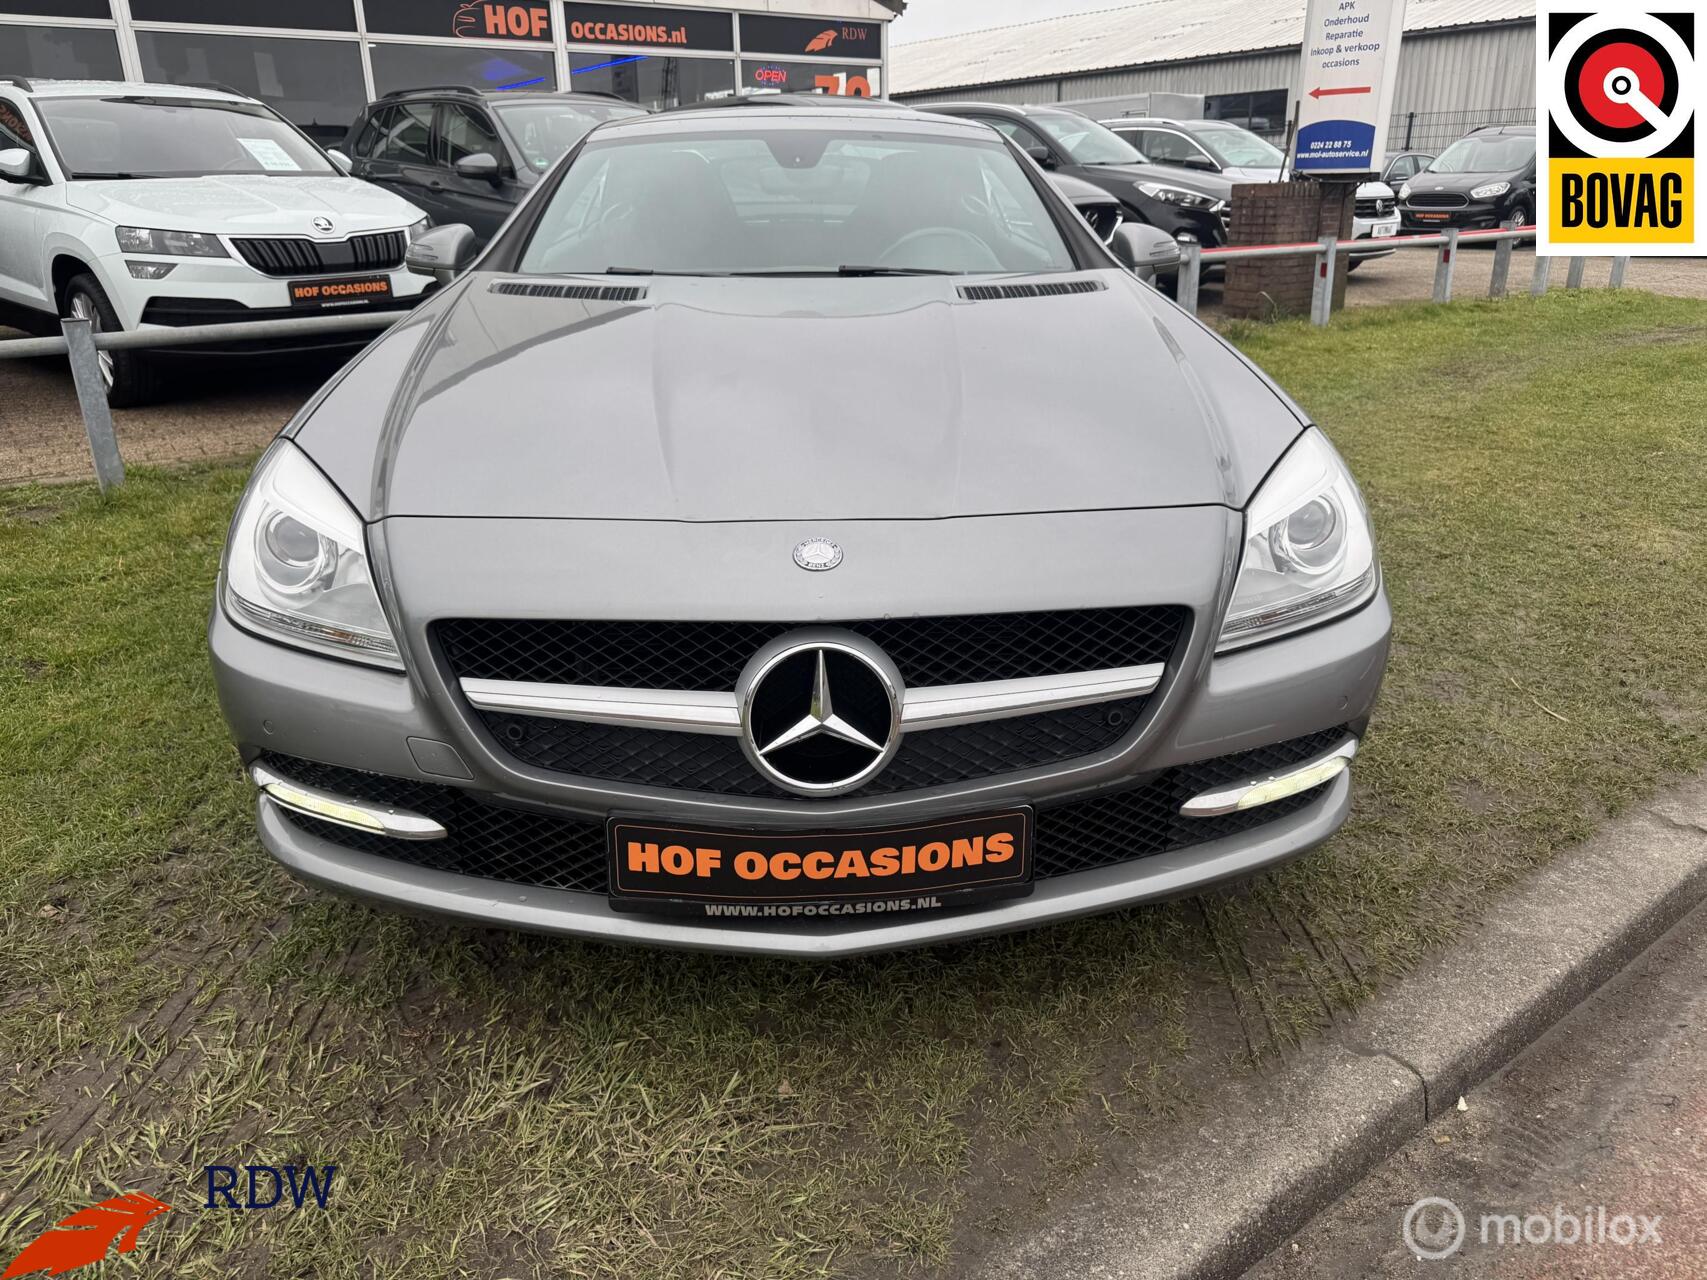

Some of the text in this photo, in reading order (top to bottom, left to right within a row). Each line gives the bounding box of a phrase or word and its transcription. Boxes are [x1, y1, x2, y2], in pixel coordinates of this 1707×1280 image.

[1339, 1, 1356, 11] APK
[483, 4, 687, 44] HOF OCCASIONS.nl
[1323, 13, 1370, 27] Onderhoud
[841, 27, 868, 41] RDW
[1325, 29, 1364, 41] Reparatie
[1310, 42, 1381, 57] Inkoop & verkoop
[1321, 58, 1361, 69] occasions
[755, 67, 787, 83] OPEN
[294, 281, 388, 298] HOF OCCASIONS
[627, 831, 1015, 881] HOF OCCASIONS
[704, 896, 942, 917] WWW.HOFOCCASIONS.NL
